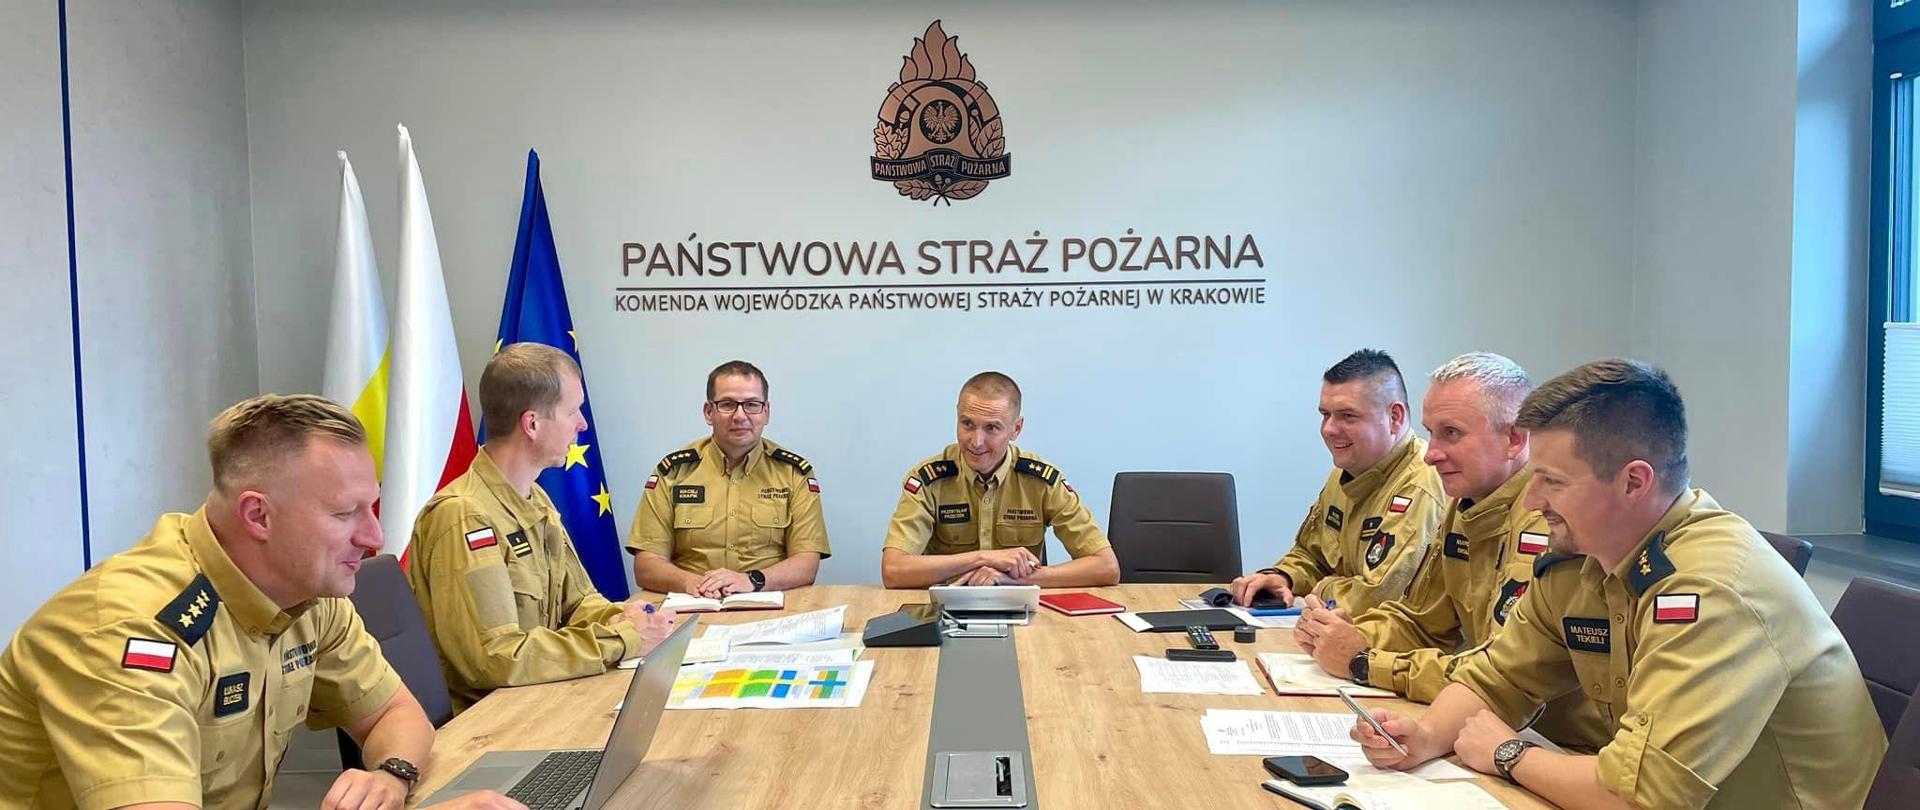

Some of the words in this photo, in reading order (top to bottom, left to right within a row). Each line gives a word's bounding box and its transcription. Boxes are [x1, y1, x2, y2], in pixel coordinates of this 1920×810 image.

[874, 160, 927, 177] PAŃSTWOWA
[929, 153, 956, 168] STRAŻ
[961, 160, 1006, 175] POŻARNA
[622, 232, 905, 277] PAŃSTWOWA
[917, 230, 1049, 275] STRAŻ
[1062, 228, 1264, 272] POŻARNA
[615, 294, 708, 312] KOMENDA
[714, 289, 843, 313] WOJEWÓDZKA
[849, 289, 971, 312] PAŃSTWOWEJ
[978, 287, 1044, 308] STRAŻY
[1050, 287, 1140, 309] POŻARNEJ
[1147, 289, 1164, 305] W
[1170, 287, 1266, 306] KRAKOWIE
[1570, 625, 1608, 636] MATEUSZ
[1576, 634, 1605, 645] TEKIELI
